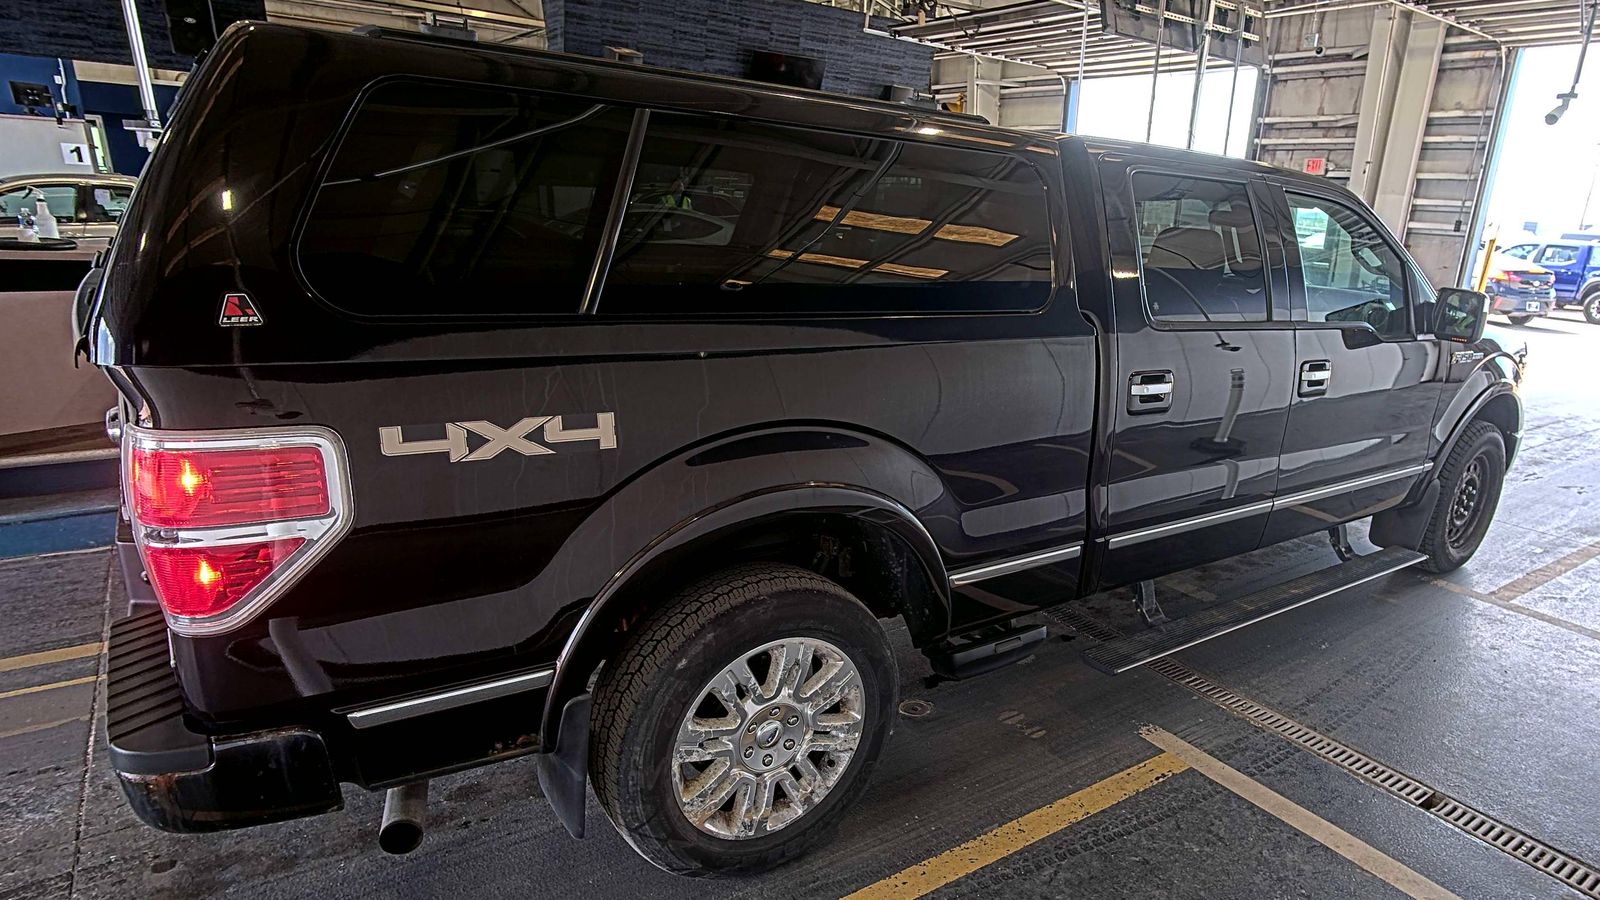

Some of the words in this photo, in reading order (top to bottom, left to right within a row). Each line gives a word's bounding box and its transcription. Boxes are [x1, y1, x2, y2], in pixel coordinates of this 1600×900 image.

[70, 146, 83, 162] 1
[1306, 159, 1323, 172] EXIT
[379, 412, 617, 463] 4X4
